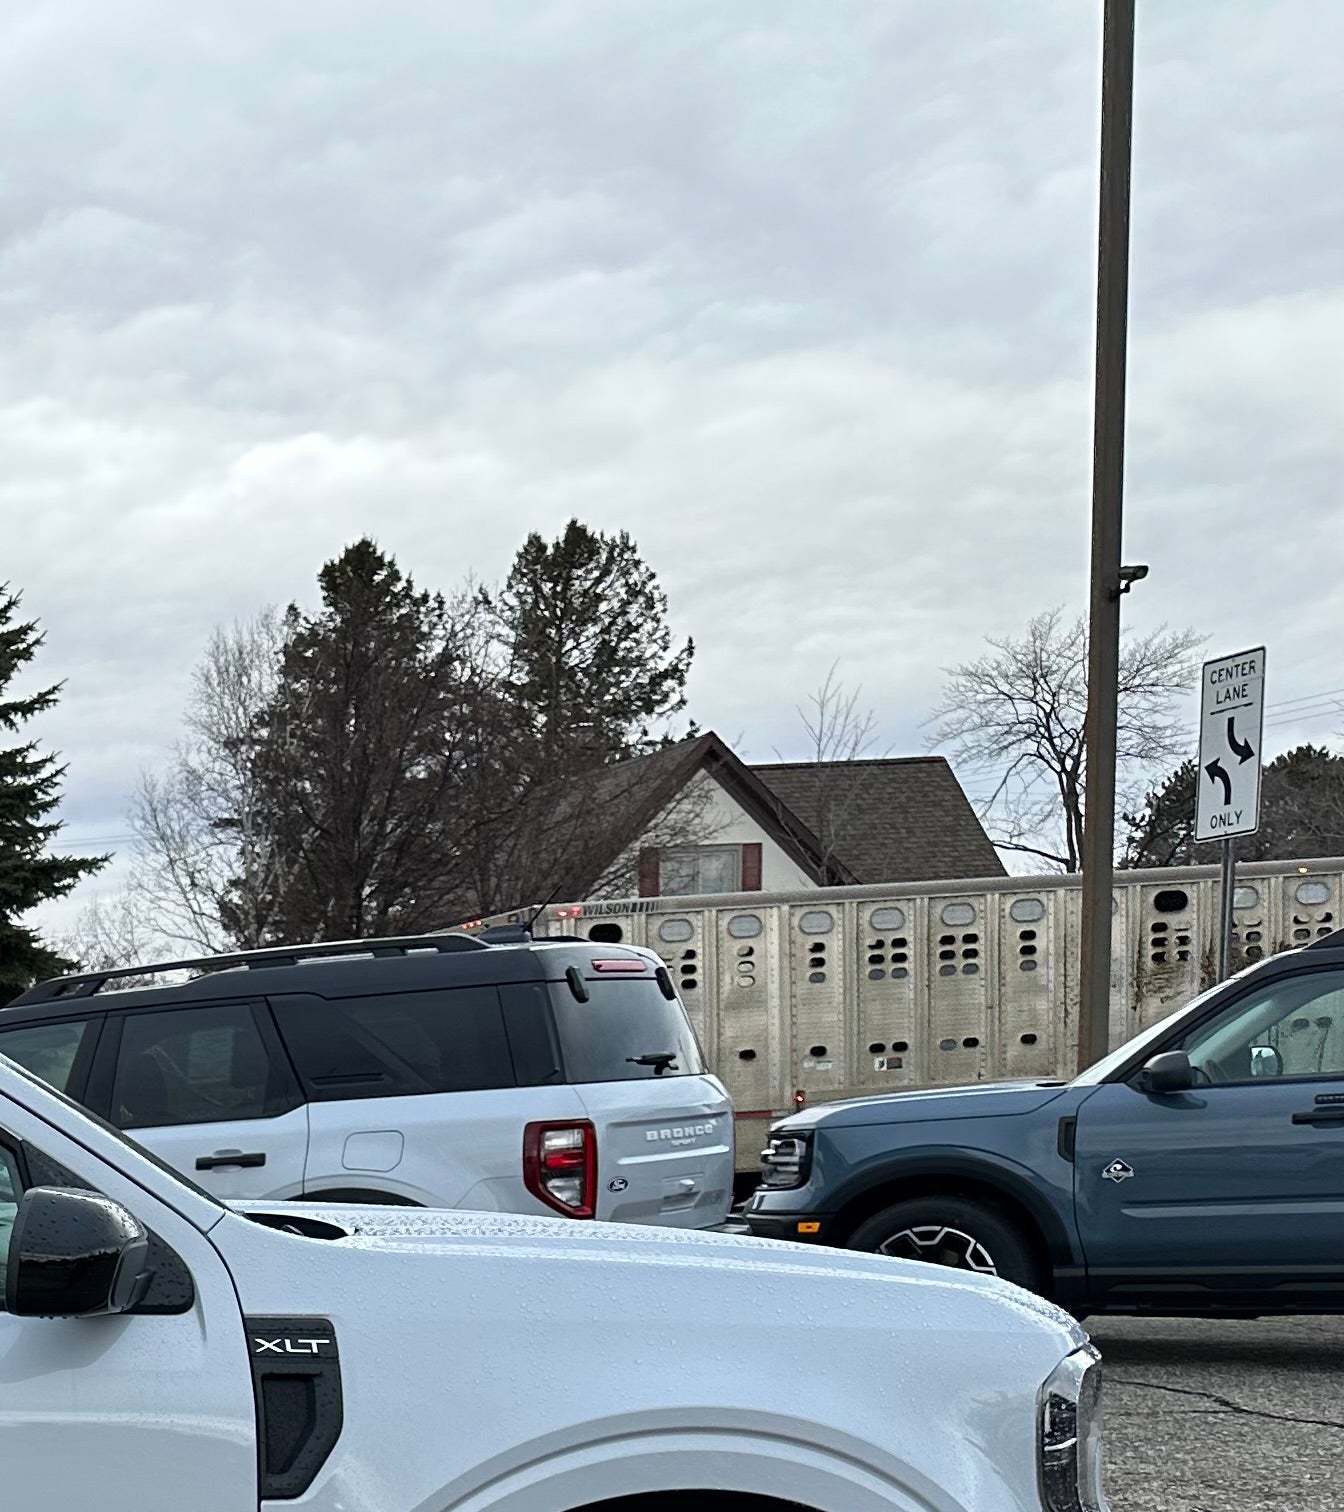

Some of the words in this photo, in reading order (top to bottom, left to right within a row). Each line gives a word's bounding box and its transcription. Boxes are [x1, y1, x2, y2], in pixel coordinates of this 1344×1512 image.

[1210, 660, 1256, 685] CENTER
[1216, 683, 1248, 704] LANE
[1210, 810, 1243, 829] ONLY
[583, 902, 631, 916] WILSON
[646, 1123, 713, 1141] BRONCO
[254, 1338, 330, 1353] XLT
